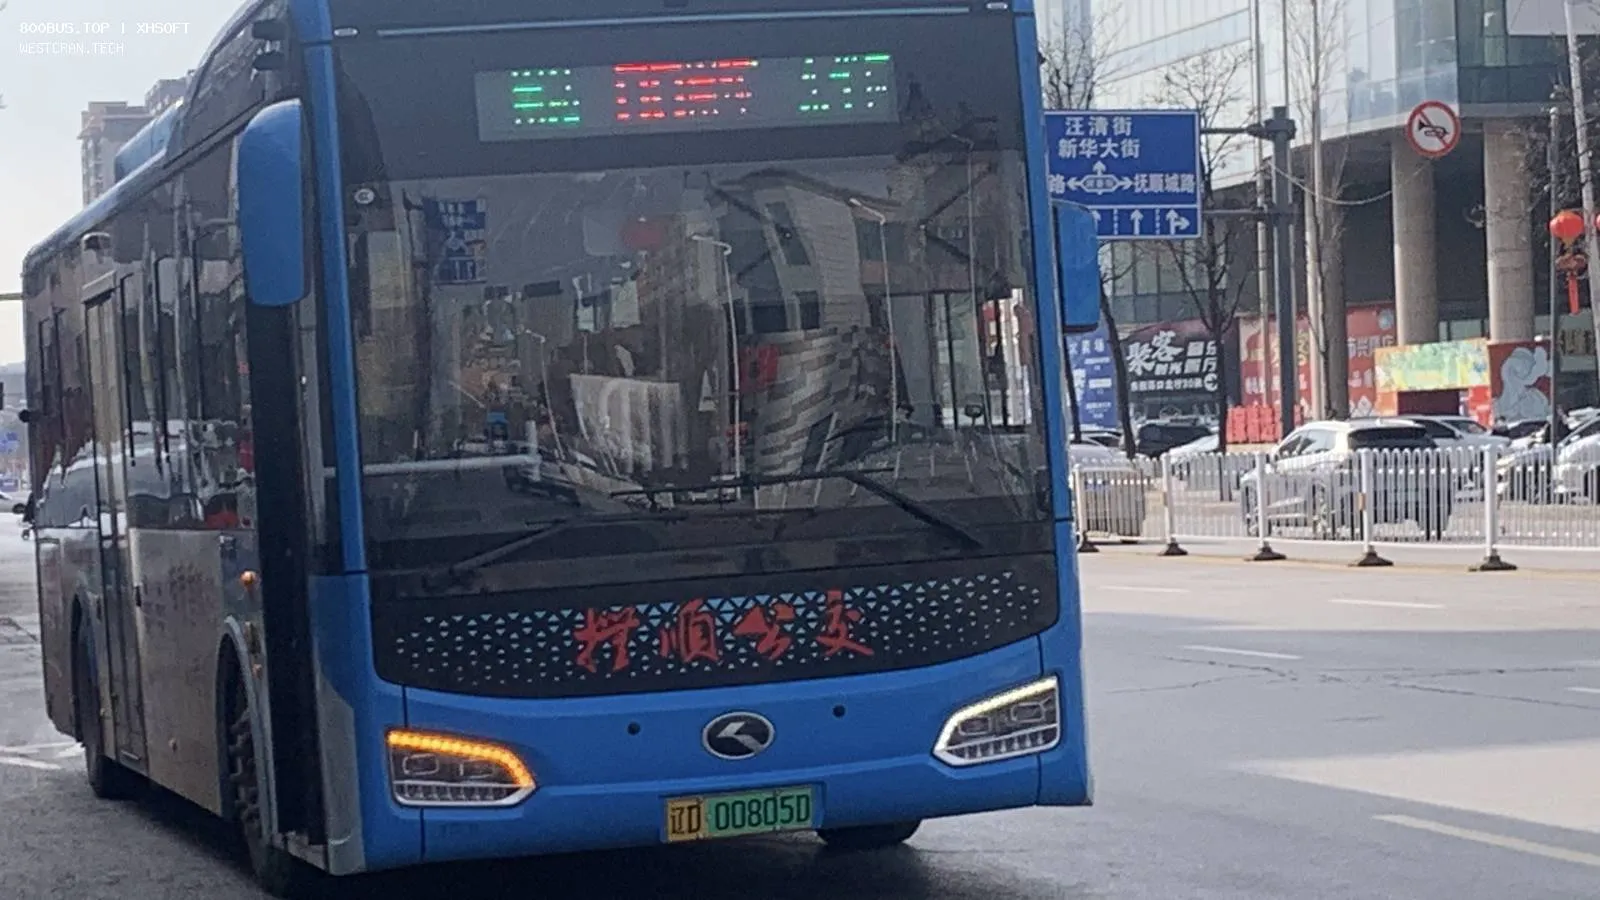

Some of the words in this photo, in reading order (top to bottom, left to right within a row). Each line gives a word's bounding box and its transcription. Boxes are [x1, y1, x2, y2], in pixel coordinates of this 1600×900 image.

[1065, 116, 1132, 136] 汪清街
[1058, 138, 1140, 159] 新华大街
[573, 589, 875, 673] 抚顺公交
